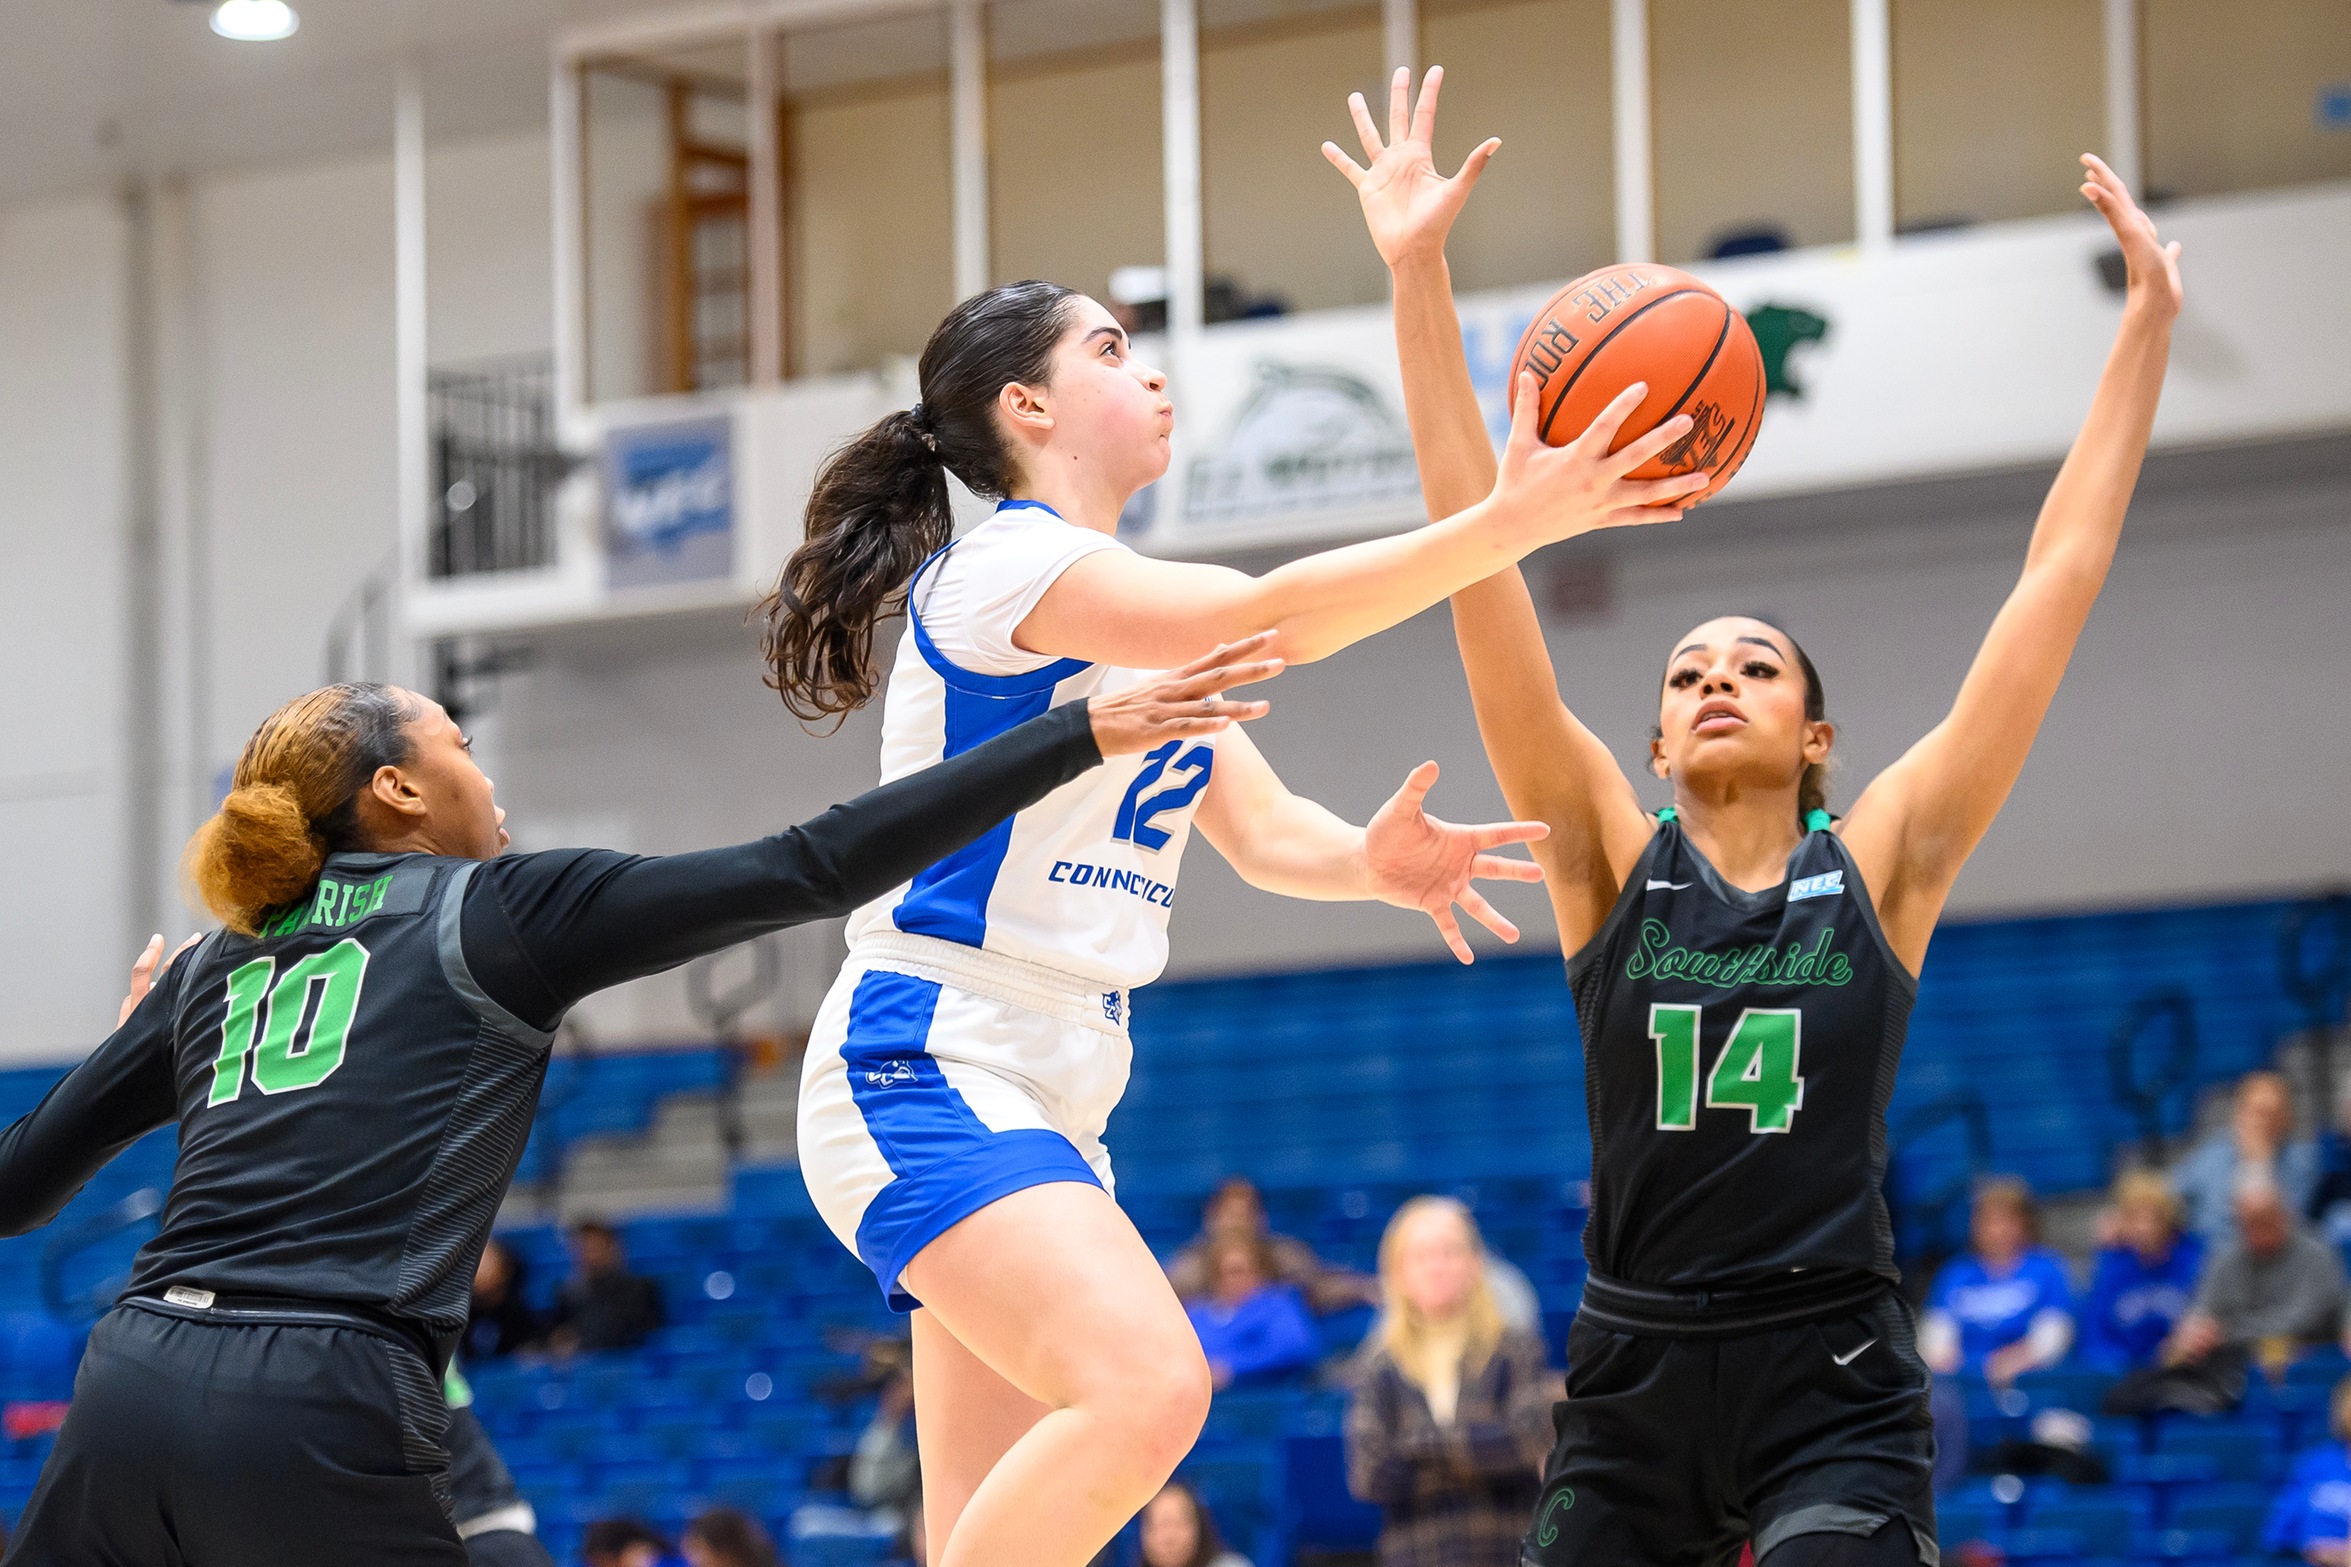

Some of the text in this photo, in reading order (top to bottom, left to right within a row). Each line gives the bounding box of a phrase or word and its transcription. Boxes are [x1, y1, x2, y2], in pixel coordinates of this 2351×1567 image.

[1572, 272, 1652, 324] THE
[1110, 739, 1214, 856] 12
[258, 875, 394, 939] PARISH
[1789, 871, 1843, 899] NEC
[1626, 917, 1854, 988] Southside
[207, 938, 371, 1109] 10
[1648, 1003, 1805, 1134] 14
